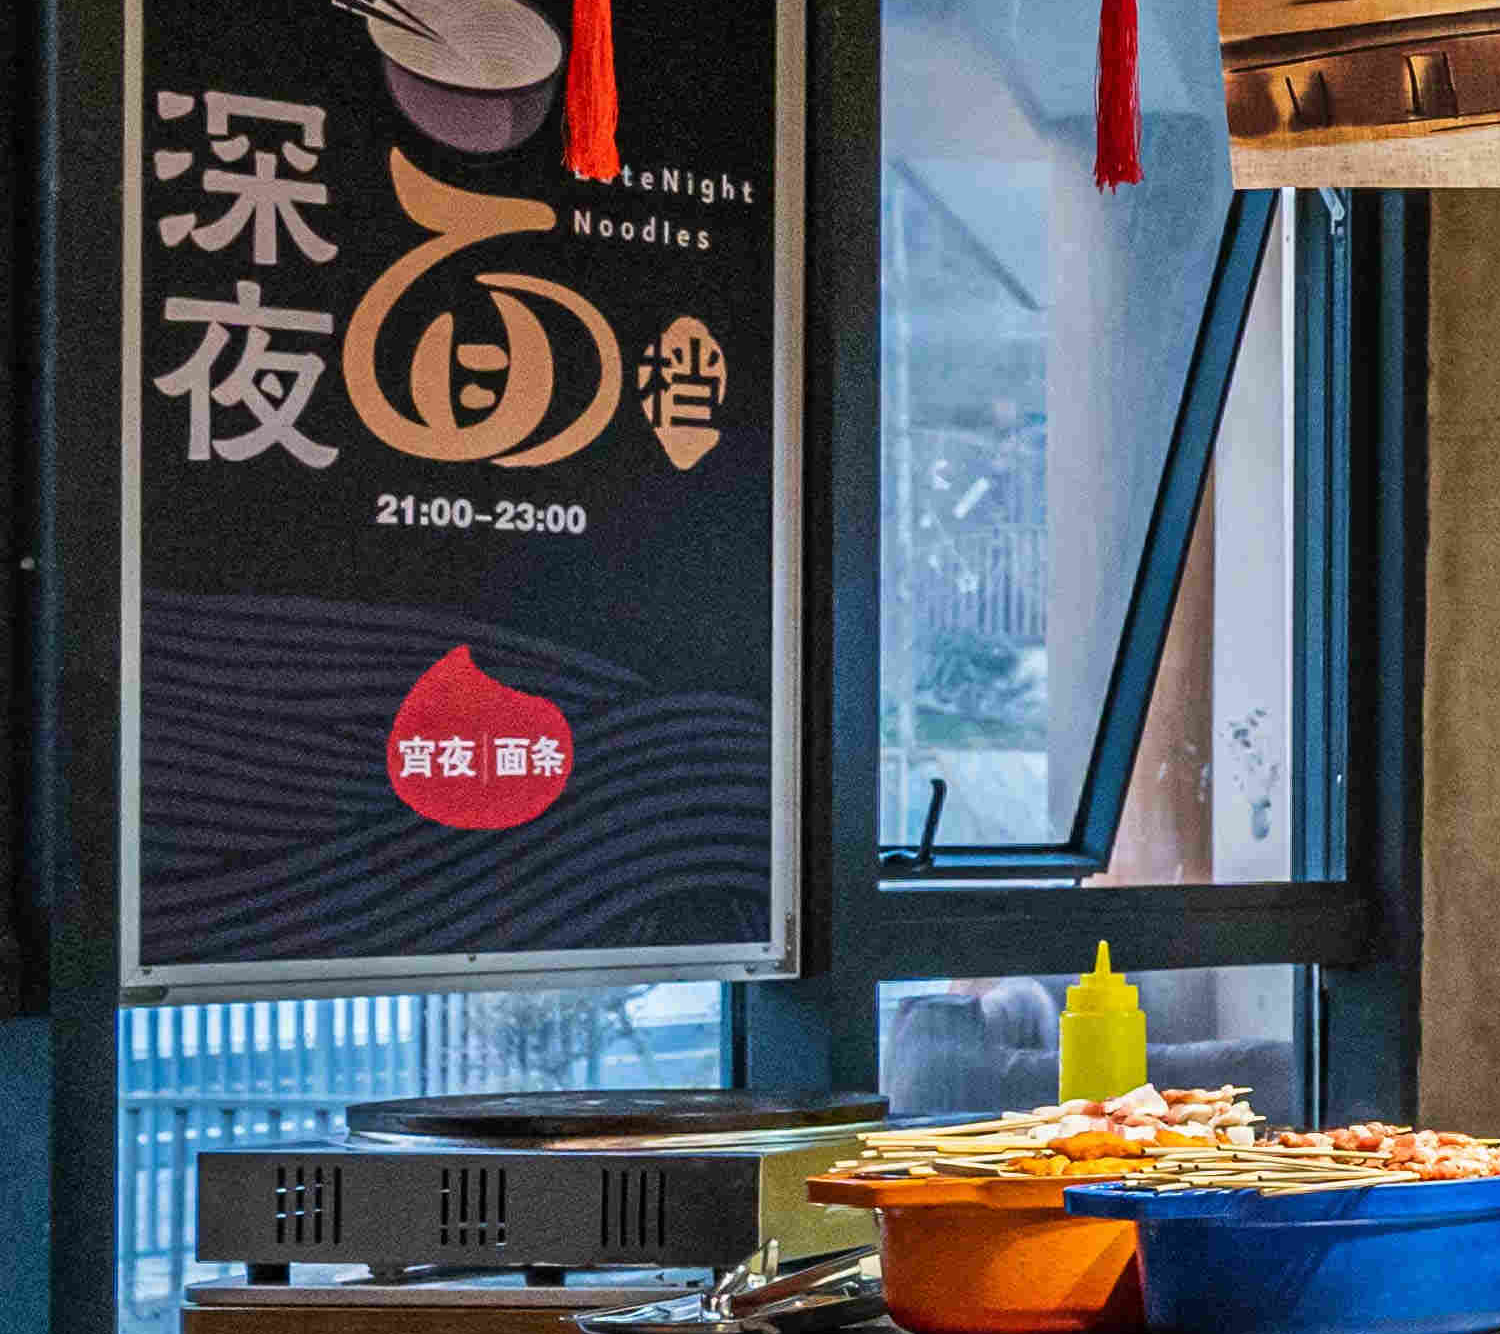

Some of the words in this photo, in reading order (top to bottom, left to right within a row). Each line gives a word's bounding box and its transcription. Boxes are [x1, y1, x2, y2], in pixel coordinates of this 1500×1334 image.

[574, 163, 754, 204] teNight
[573, 210, 710, 249] Noodles
[153, 90, 339, 469] 深夜
[375, 493, 587, 535] 21:00-23:00
[397, 735, 476, 779] 宵夜
[494, 735, 566, 777] 面条
